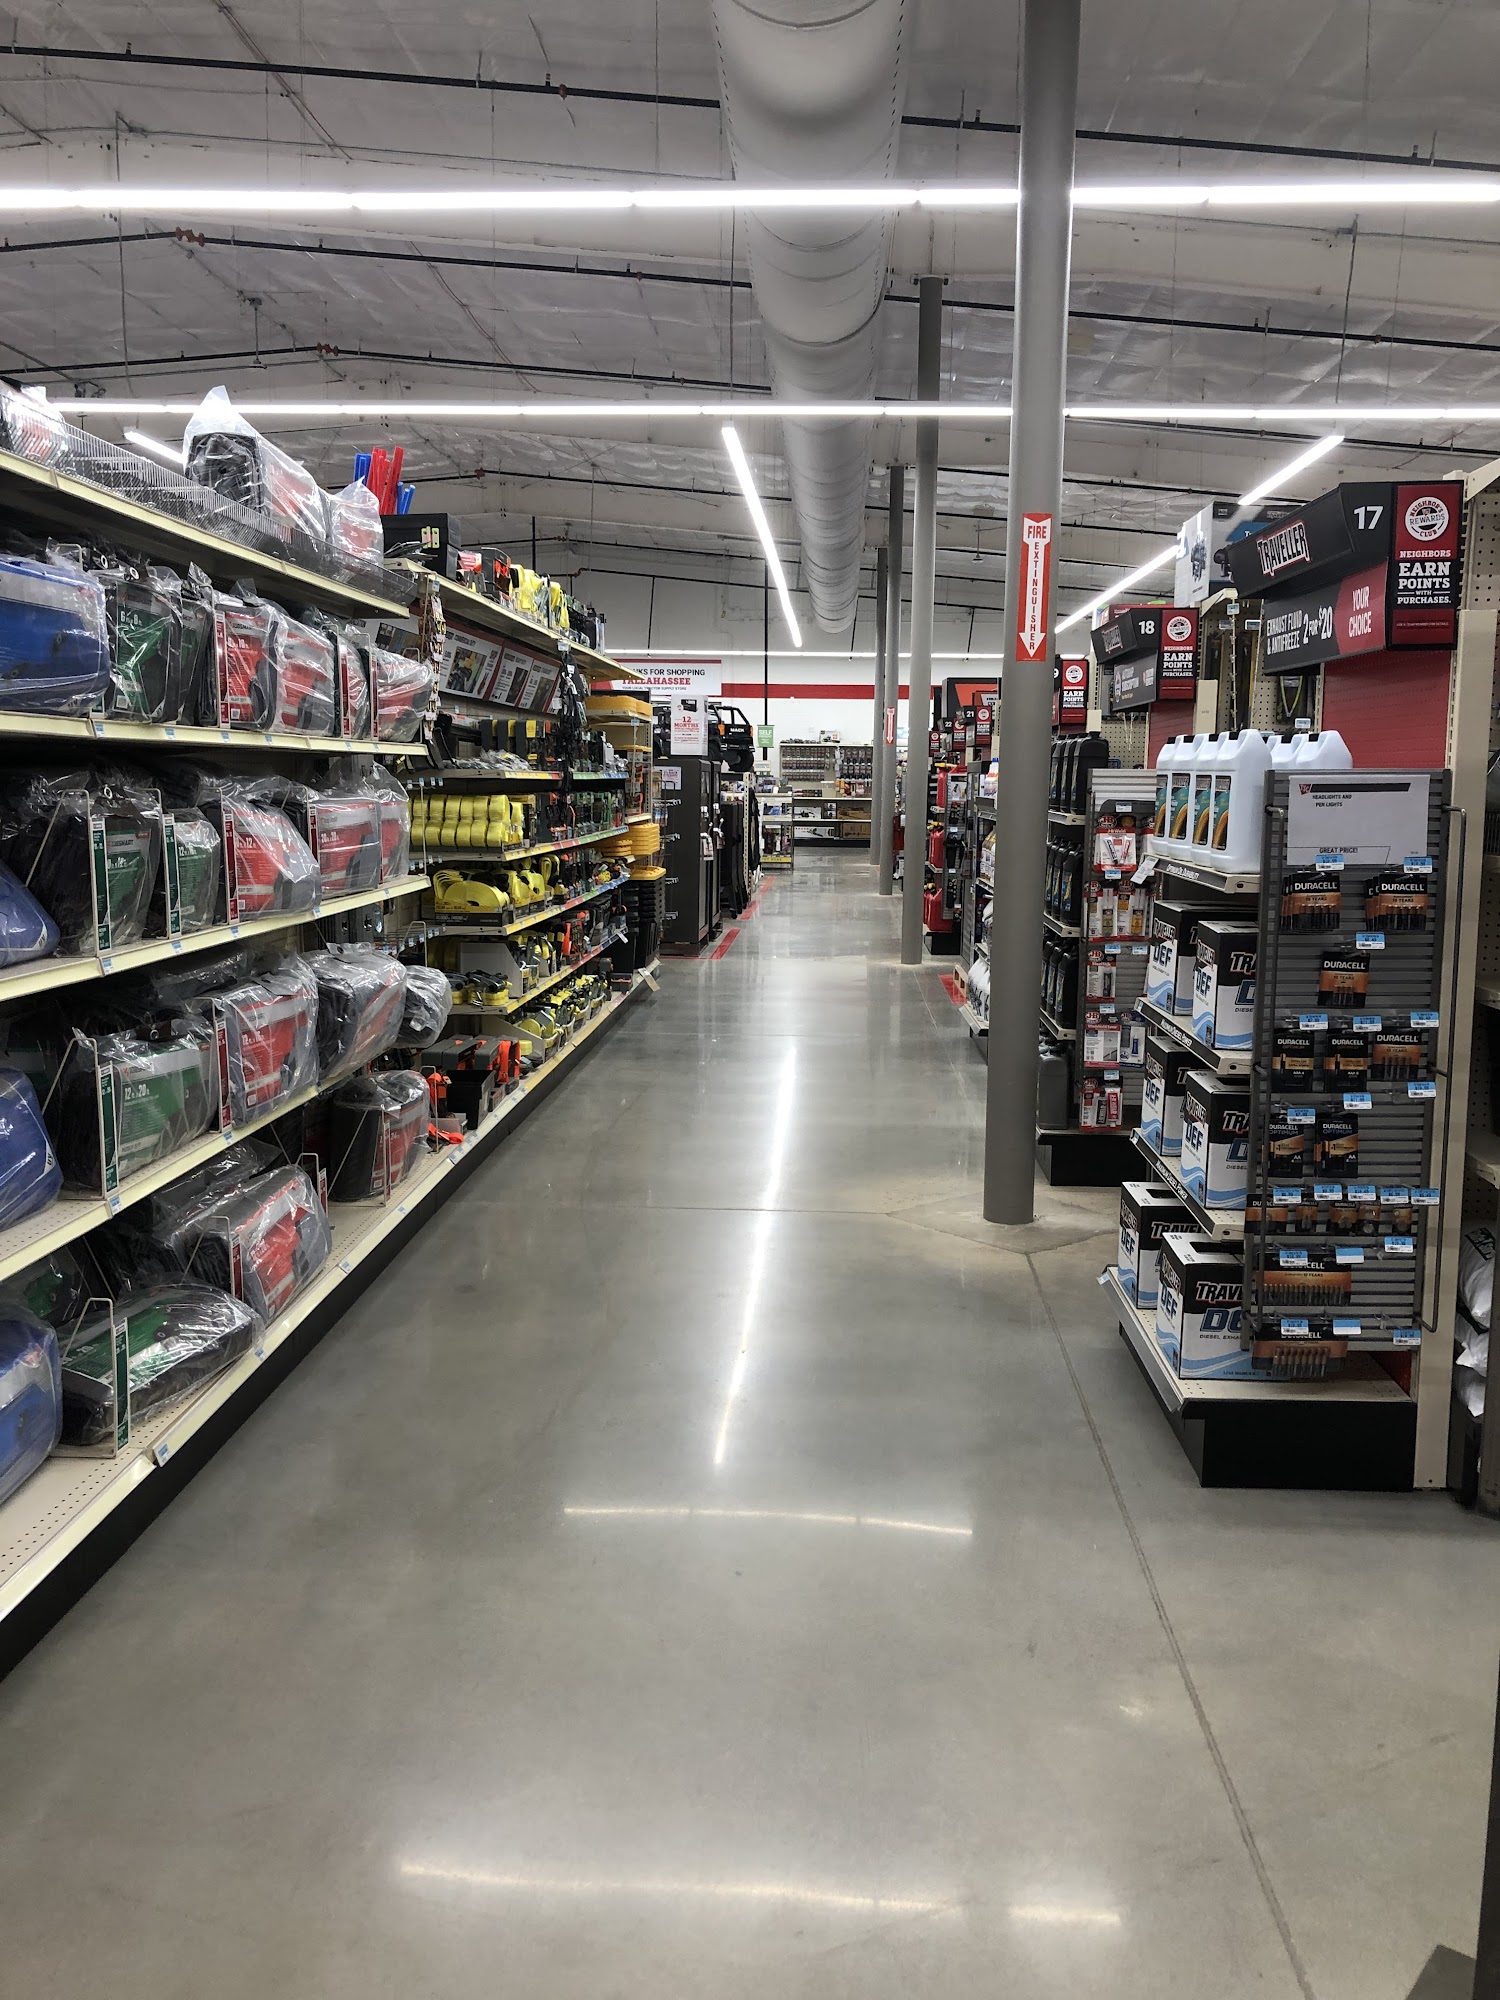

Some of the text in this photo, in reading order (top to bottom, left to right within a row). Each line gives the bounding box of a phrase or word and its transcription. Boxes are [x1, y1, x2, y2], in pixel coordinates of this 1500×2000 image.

[1353, 505, 1384, 530] 17
[1409, 513, 1446, 526] REWARDS
[1027, 525, 1047, 539] FIRE
[1419, 528, 1438, 538] CLUB
[1256, 522, 1312, 577] TRAVELLER
[1400, 550, 1451, 558] NEIGHBORS
[1399, 562, 1451, 577] EARN
[1398, 578, 1451, 589] POINTS
[1028, 541, 1040, 650] EXTINGUISHER
[1352, 585, 1370, 611] YOUR
[1397, 596, 1452, 605] PURCHASES.
[1138, 620, 1155, 634] 18
[1266, 609, 1302, 637] EXHAUST FLUID
[1303, 606, 1333, 645] 2 FOR $20
[1348, 611, 1372, 638] CHOICE
[1271, 630, 1300, 655] ANTIFREEZE
[1163, 652, 1193, 661] EARN
[667, 668, 706, 676] SHOPPING
[622, 677, 691, 685] TALLAHASSEE
[1294, 882, 1338, 890] DURACELL
[1381, 883, 1425, 891] DURACELL
[1152, 943, 1173, 968] DEF
[1324, 961, 1366, 970] DURACELL
[1195, 967, 1212, 998] DEF
[1377, 1035, 1419, 1043] DURACELL
[1144, 1076, 1160, 1106] DEF
[1185, 1121, 1203, 1150] DEF
[1120, 1228, 1136, 1258] DEF
[1160, 1284, 1178, 1320] DEF
